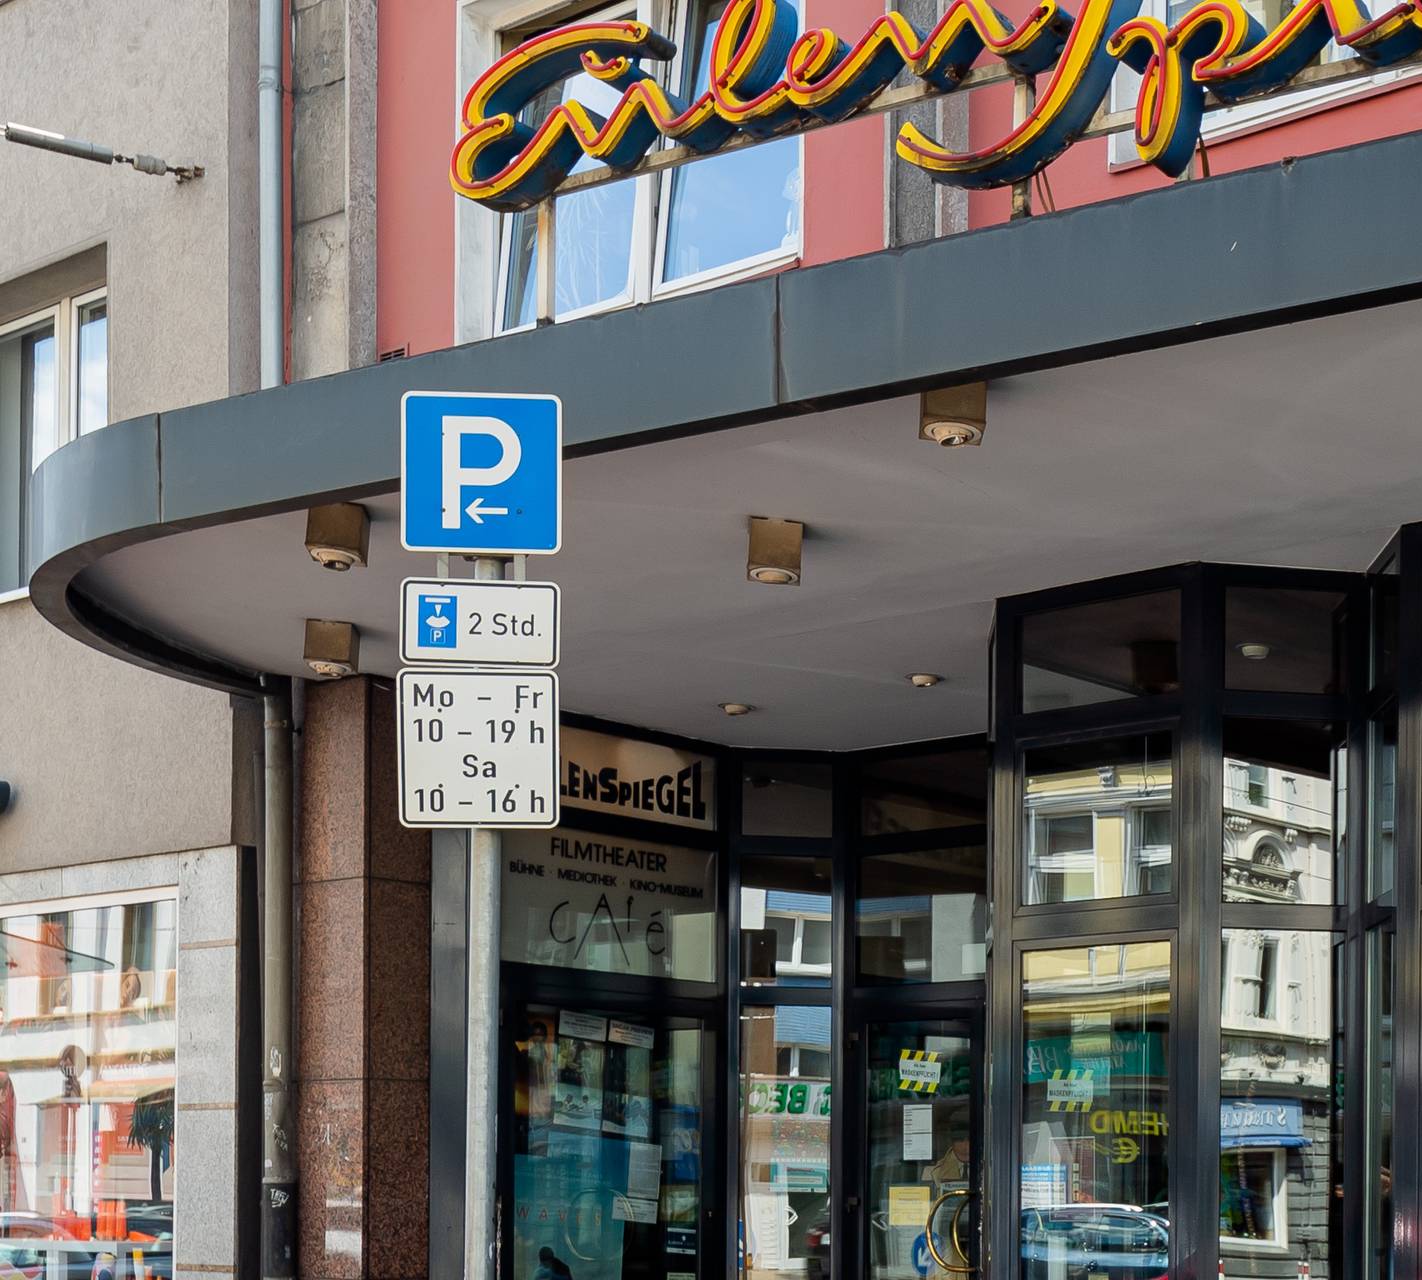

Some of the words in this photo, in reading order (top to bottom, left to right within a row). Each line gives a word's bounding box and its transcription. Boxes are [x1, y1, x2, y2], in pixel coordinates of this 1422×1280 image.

[442, 416, 521, 528] P
[468, 613, 482, 635] 2
[491, 613, 542, 637] Std.
[413, 684, 454, 707] Mo
[515, 686, 544, 708] Fr
[413, 719, 443, 743] 10
[487, 720, 516, 744] 19
[530, 721, 545, 744] h
[462, 754, 497, 778] Sa
[415, 789, 443, 813] 10
[487, 789, 516, 813] 16
[530, 790, 545, 813] h
[551, 836, 668, 873] FILMTHEATER
[509, 859, 545, 877] BÜHNE
[557, 868, 617, 887] MEDIOTHEK
[629, 879, 703, 899] KINO-MUSEUM
